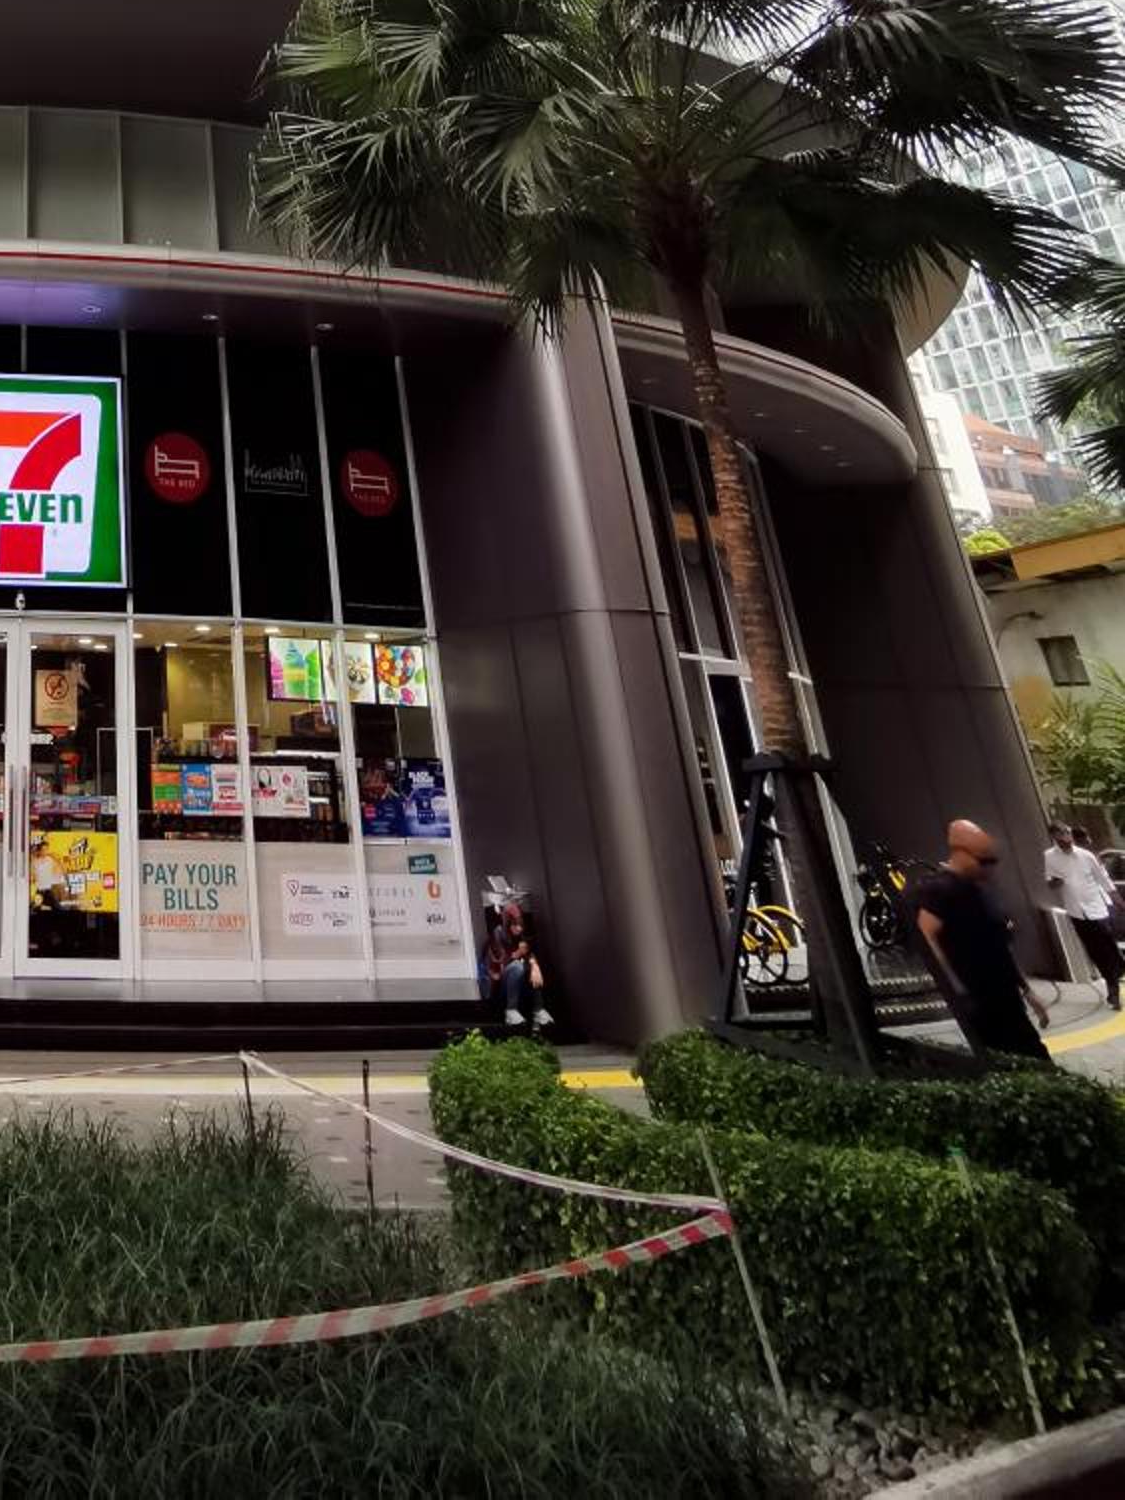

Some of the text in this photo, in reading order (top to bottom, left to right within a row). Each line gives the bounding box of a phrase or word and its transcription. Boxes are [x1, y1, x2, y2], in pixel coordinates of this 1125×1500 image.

[142, 863, 236, 886] PAY YOUR
[164, 888, 219, 911] BILLS
